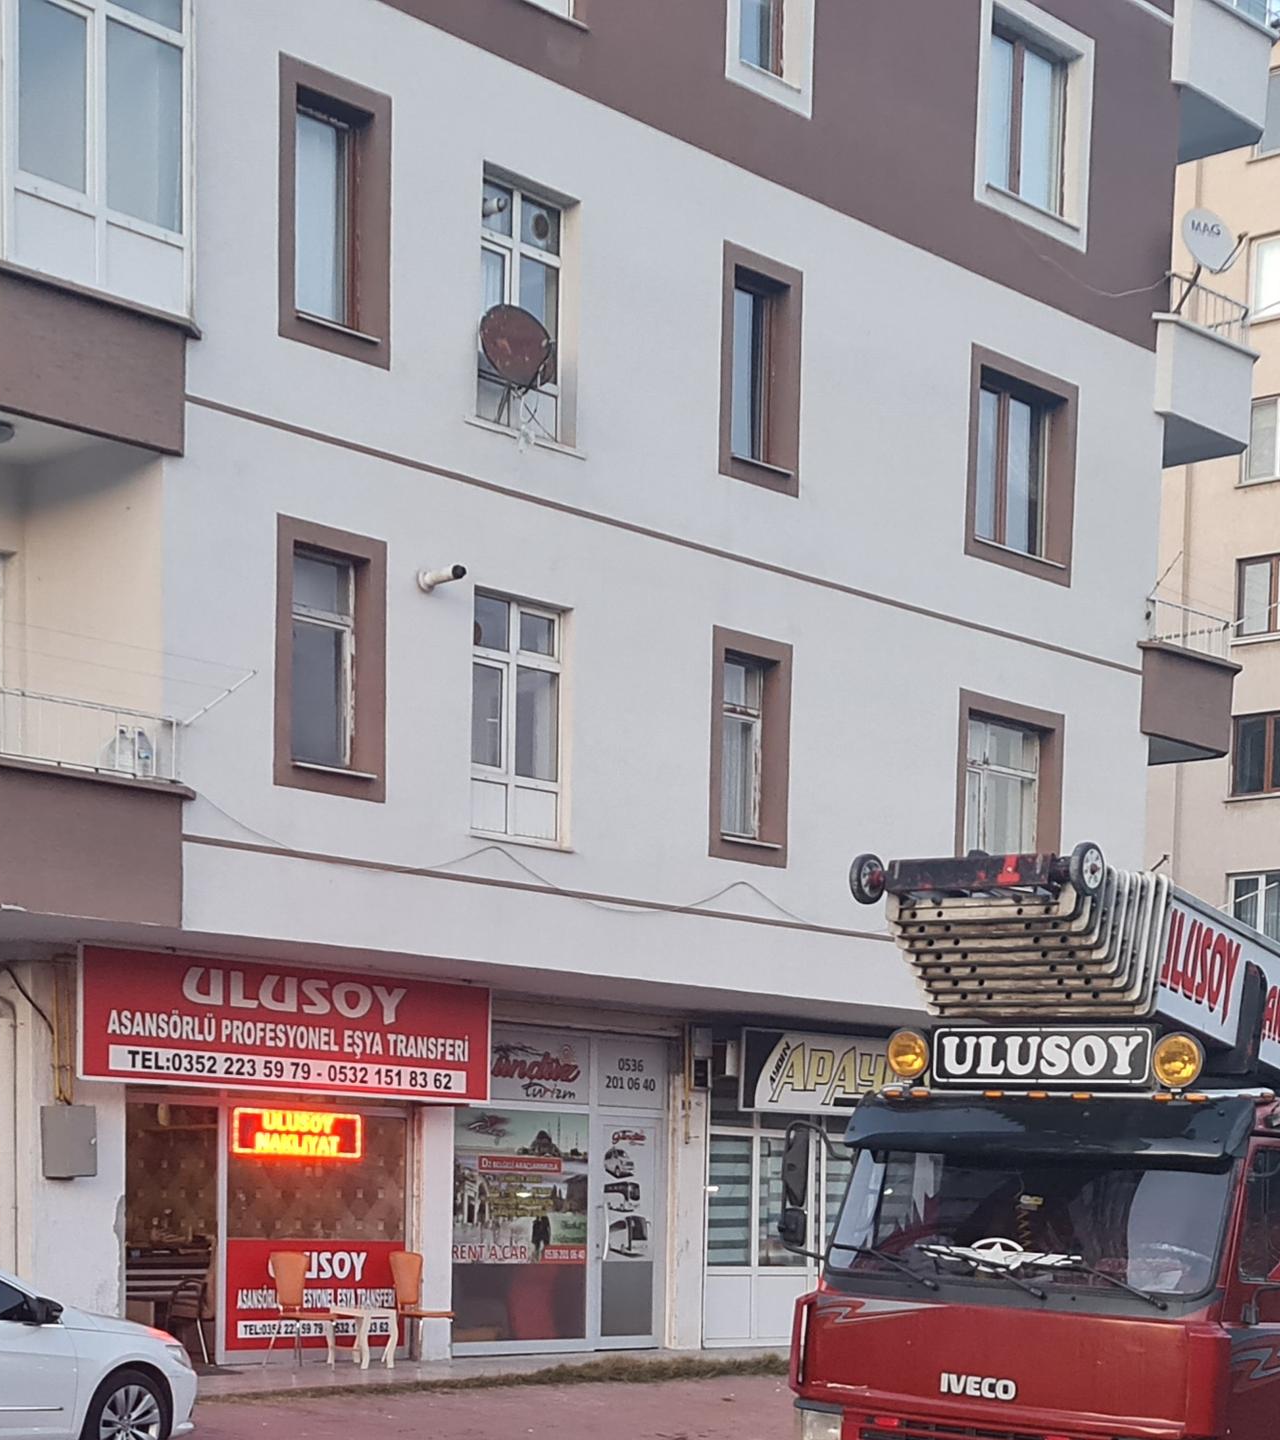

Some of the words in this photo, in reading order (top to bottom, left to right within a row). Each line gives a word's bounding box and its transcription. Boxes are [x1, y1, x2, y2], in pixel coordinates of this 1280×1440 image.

[182, 966, 408, 1025] ULUSOY
[107, 1009, 216, 1042] ASANSÖRLÜ
[221, 1019, 339, 1052] PROFESYONEL
[343, 1029, 383, 1059] EŞYA
[387, 1033, 469, 1063] TRANSFERİ
[128, 1050, 217, 1074] TEL:0352
[224, 1057, 256, 1077] 223
[263, 1060, 284, 1078] 59
[290, 1062, 311, 1080] 79
[328, 1064, 368, 1084] 0532
[374, 1068, 402, 1087] 151
[409, 1071, 428, 1088] 83
[433, 1073, 452, 1090] 62
[618, 1058, 644, 1072] 0536
[942, 1035, 1144, 1076] ULUSOY
[606, 1075, 624, 1089] 201
[627, 1077, 640, 1090] 06
[642, 1078, 656, 1091] 40
[769, 1041, 896, 1105] APAY
[263, 1110, 335, 1134] ULUSOY
[268, 1251, 368, 1282] USOY
[452, 1245, 485, 1260] RENT
[489, 1246, 497, 1260] A
[502, 1246, 527, 1260] CAR
[939, 1372, 1016, 1400] IVECO
